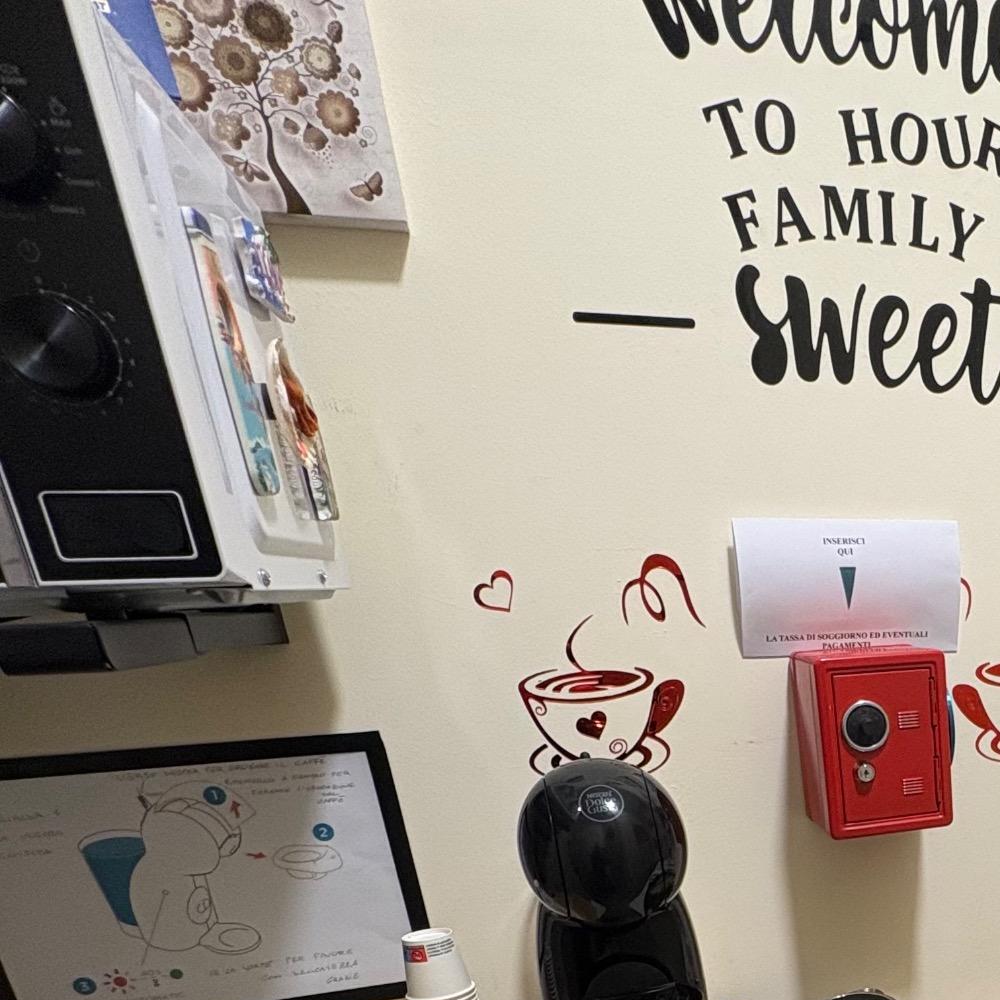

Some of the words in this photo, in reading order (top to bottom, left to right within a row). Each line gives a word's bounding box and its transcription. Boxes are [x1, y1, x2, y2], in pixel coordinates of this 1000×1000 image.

[702, 98, 796, 159] TO
[721, 184, 985, 262] FAMILY
[823, 537, 866, 546] INSERISCI
[837, 548, 854, 557] QUI
[766, 634, 778, 642] LA
[779, 633, 805, 642] TASSA
[806, 633, 816, 641] DI
[817, 632, 868, 641] SOGGIORNO
[869, 631, 881, 639] ED
[882, 630, 929, 639] EVENTUALI
[822, 641, 872, 650] PAGAMENTI
[587, 805, 619, 815] Guso
